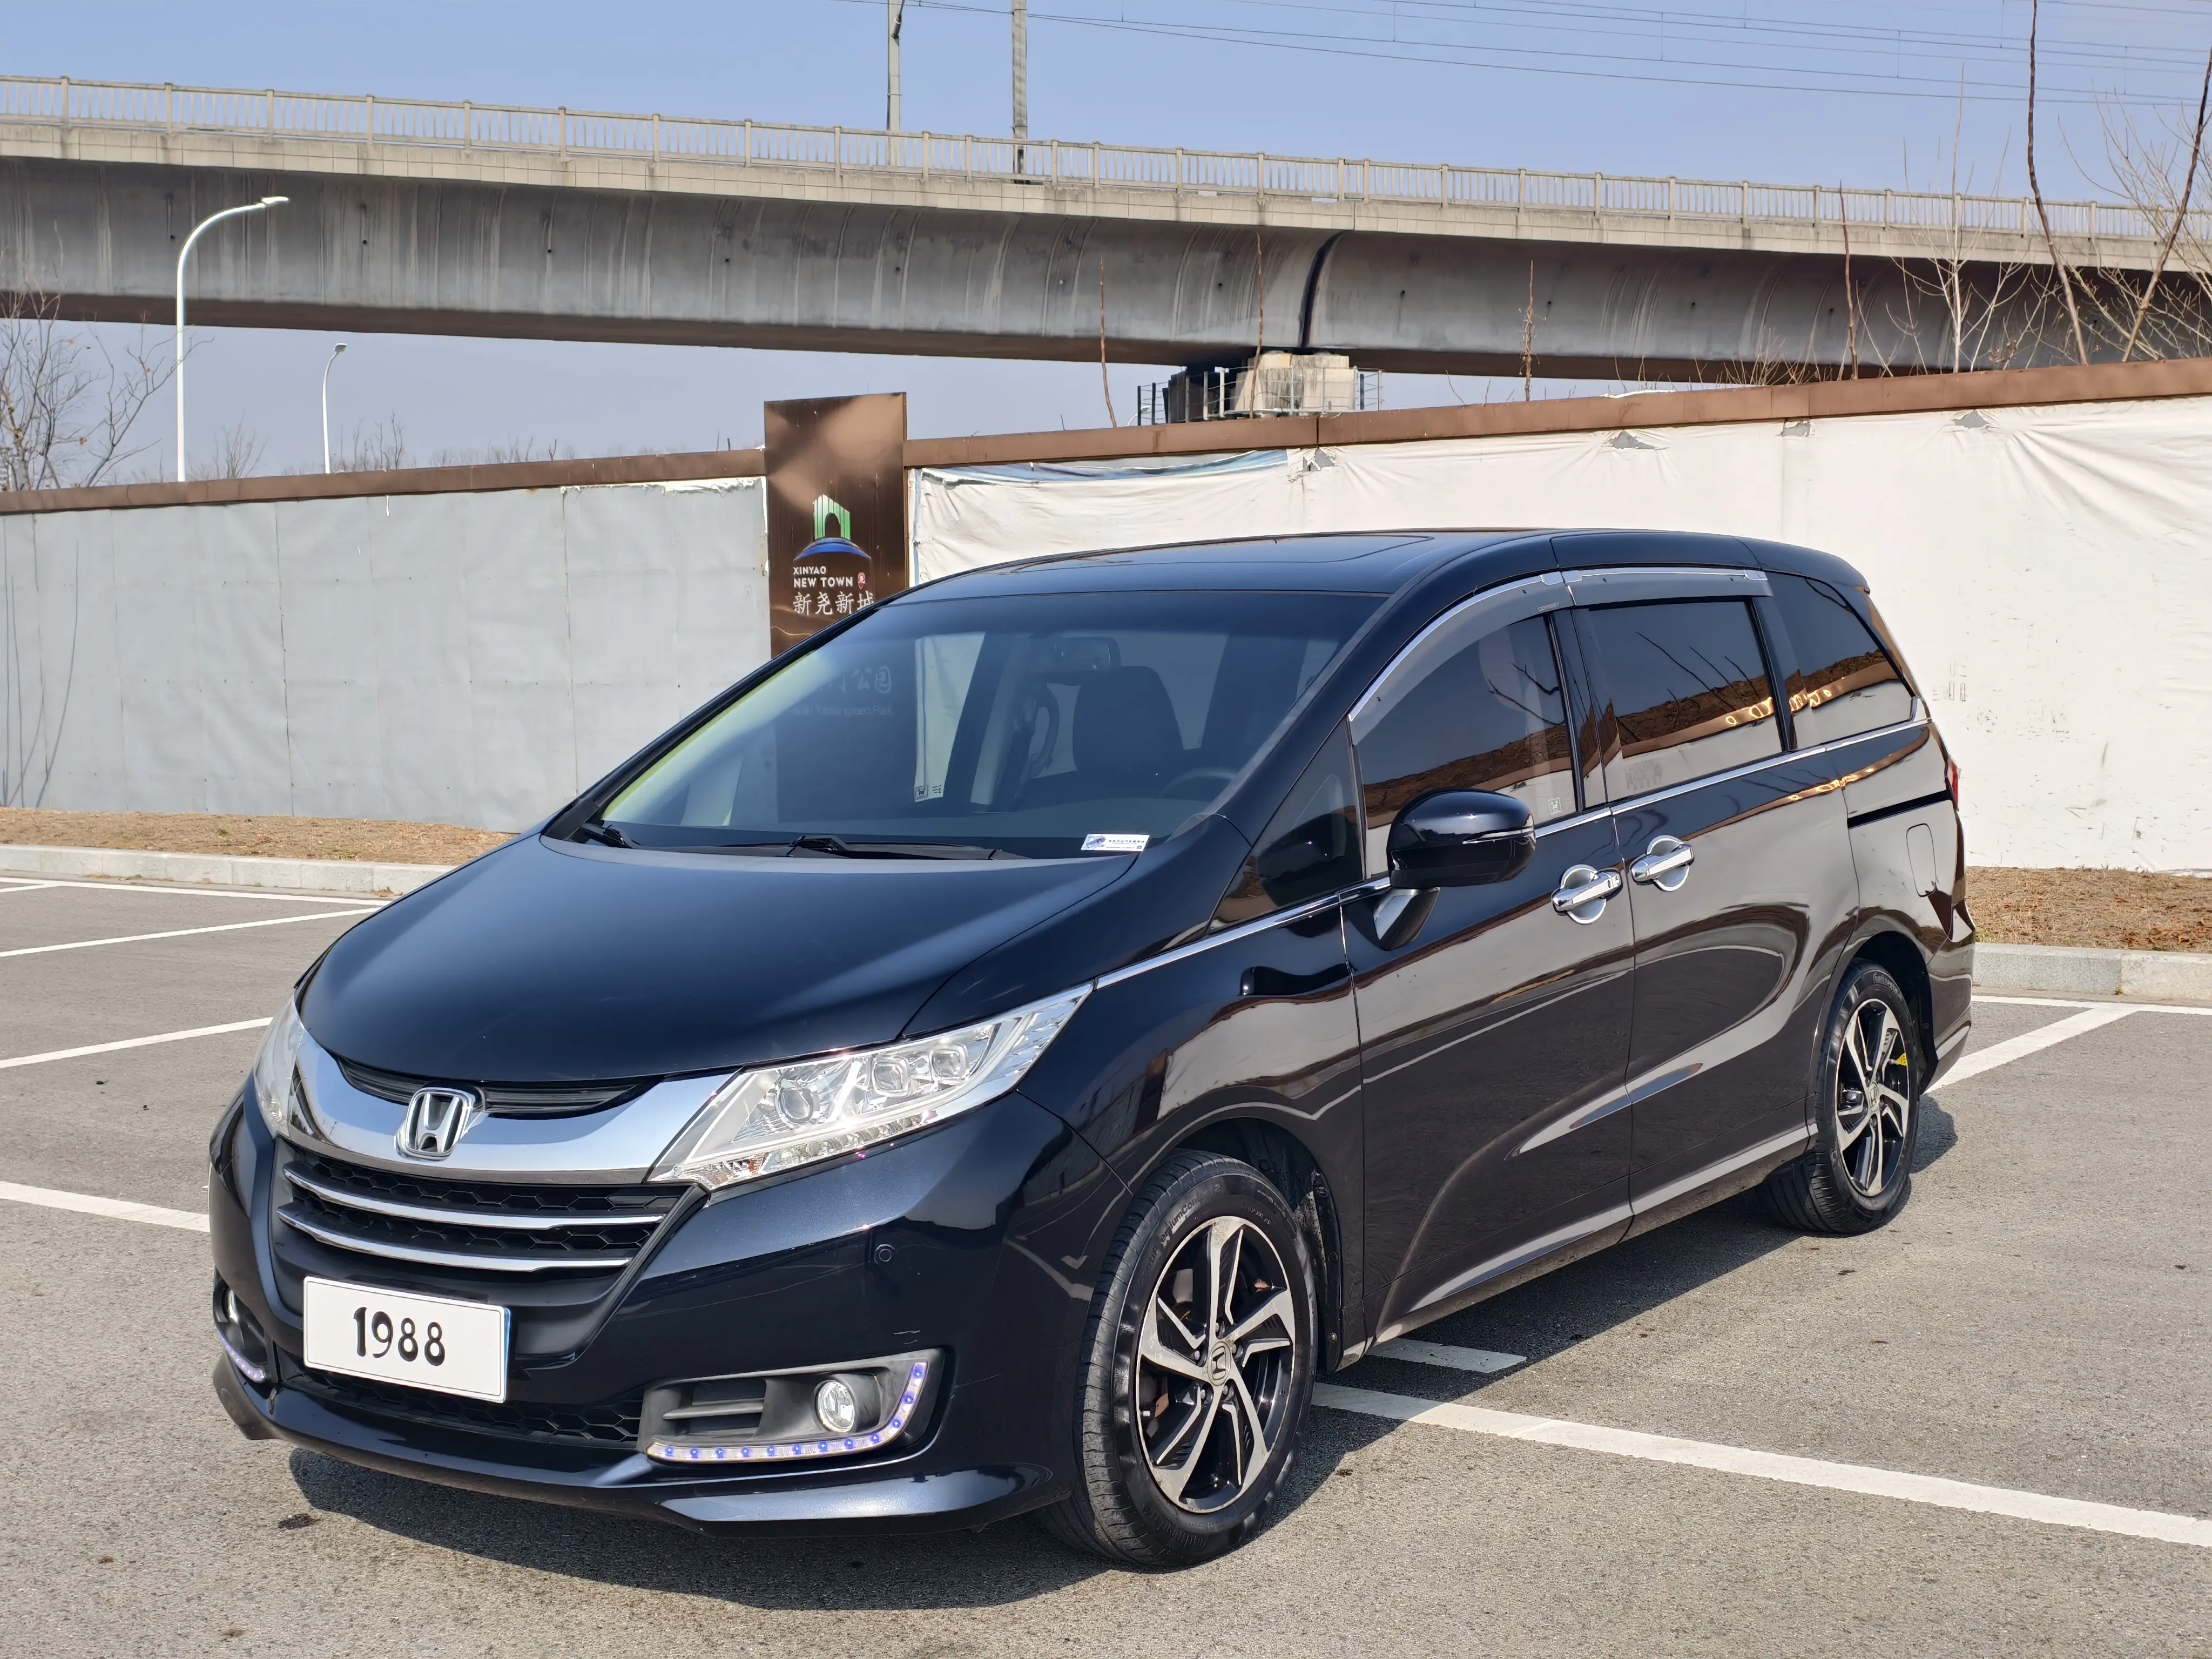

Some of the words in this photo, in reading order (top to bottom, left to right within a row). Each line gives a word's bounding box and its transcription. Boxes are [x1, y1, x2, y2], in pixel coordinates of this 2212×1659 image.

[793, 566, 827, 575] XINYAO
[793, 577, 817, 588] NEW
[820, 576, 853, 587] TOWN
[353, 1306, 445, 1366] 1988
